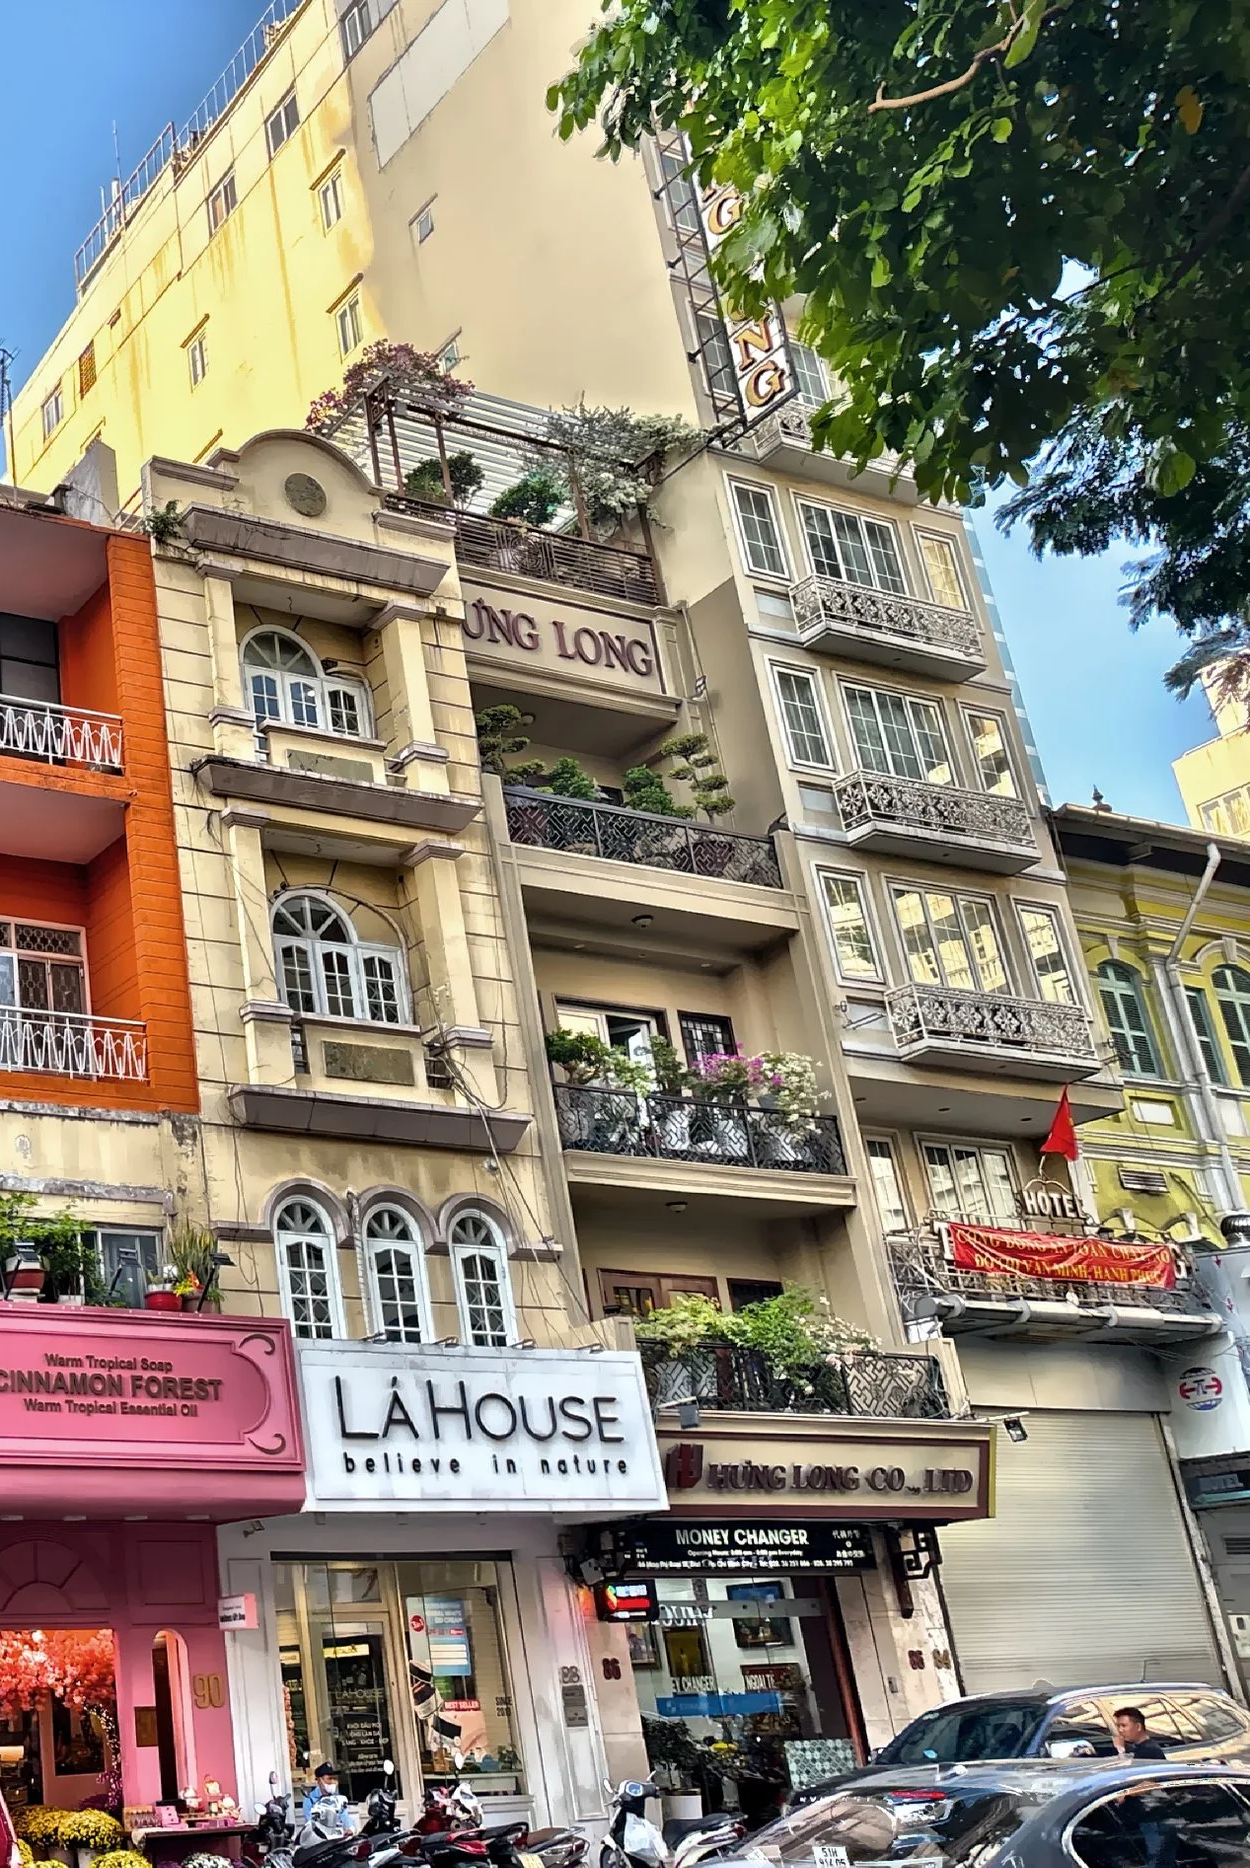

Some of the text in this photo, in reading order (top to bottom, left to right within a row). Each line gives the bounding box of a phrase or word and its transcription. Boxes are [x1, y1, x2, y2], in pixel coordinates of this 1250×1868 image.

[552, 620, 653, 676] LONG
[1023, 1190, 1087, 1219] HOTEL
[45, 1353, 173, 1373] Warm Tropical Soap
[131, 1375, 223, 1400] FOREST
[24, 1398, 198, 1417] Warm Tropical Essential Oil
[344, 1452, 627, 1474] believe in nature
[707, 1460, 787, 1491] HƯNG
[790, 1463, 860, 1491] LONG
[924, 1469, 973, 1493] LTD
[676, 1529, 809, 1546] MONEY CHANGER
[193, 1674, 225, 1709] 90
[444, 1701, 480, 1710] BEST SELLER
